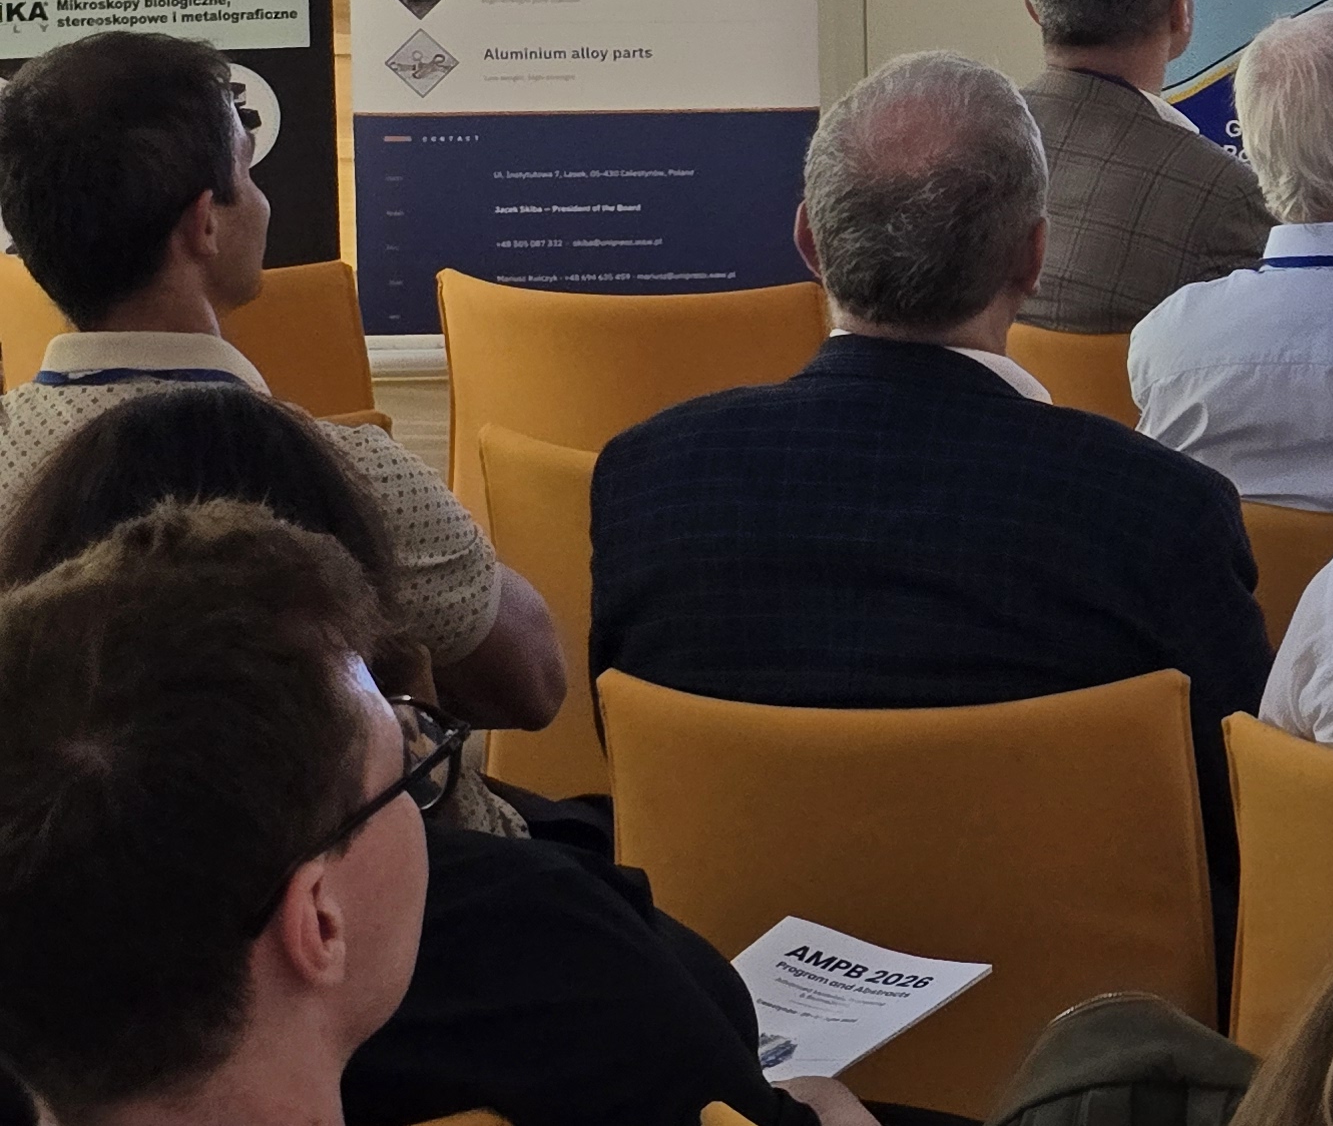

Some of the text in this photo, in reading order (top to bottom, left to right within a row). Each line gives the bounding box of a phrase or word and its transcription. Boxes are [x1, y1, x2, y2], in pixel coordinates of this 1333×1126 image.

[57, 13, 168, 29] stereoskopowe
[181, 9, 298, 26] metalograficzne
[484, 46, 653, 62] Aluminium alloy parts
[775, 961, 830, 985] Program
[828, 979, 855, 992] and
[852, 985, 911, 999] Abstracts
[784, 945, 935, 989] AMPB 2026
